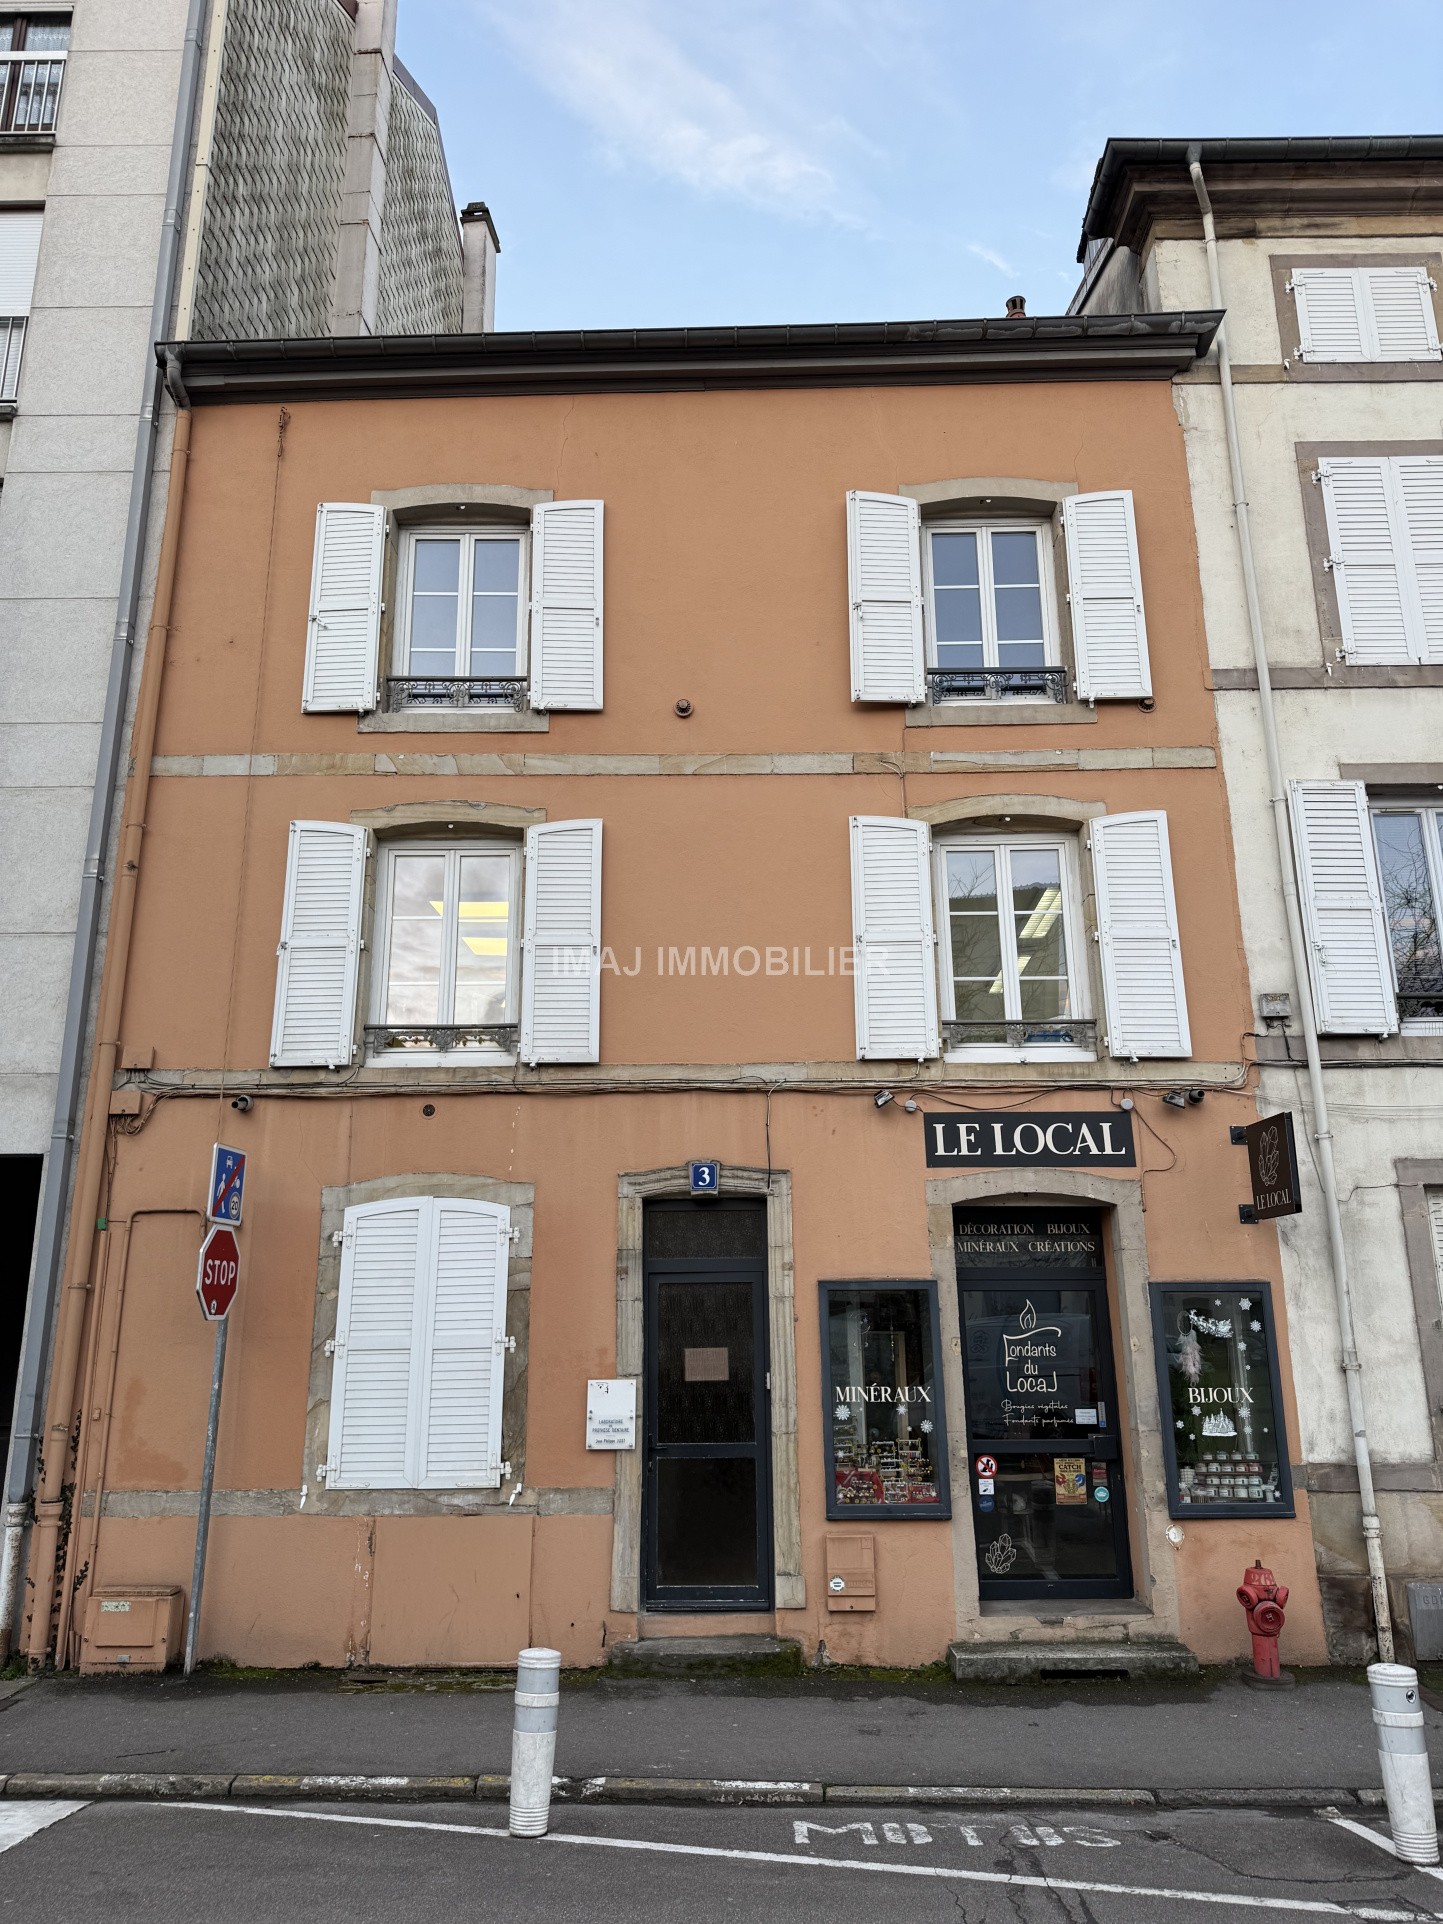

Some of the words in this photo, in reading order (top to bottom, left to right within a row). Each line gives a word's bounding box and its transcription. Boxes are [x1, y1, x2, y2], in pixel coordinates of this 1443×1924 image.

[932, 1123, 982, 1156] LE
[990, 1122, 1126, 1155] LOCAL
[698, 1166, 710, 1186] 3
[231, 1200, 238, 1210] 20
[1256, 1194, 1266, 1211] LE
[1266, 1188, 1291, 1208] LOCAL
[959, 1222, 1034, 1235] DÉCORATION
[1047, 1223, 1090, 1235] BIJOUX
[957, 1240, 1019, 1253] MINÉRAUX
[1028, 1239, 1095, 1252] CRÉATIONS
[204, 1258, 236, 1286] STOP
[1024, 1359, 1038, 1375] du
[836, 1382, 932, 1403] MINÉRAUX
[1188, 1387, 1255, 1403] BIJOUX
[1001, 1398, 1035, 1413] Bougies
